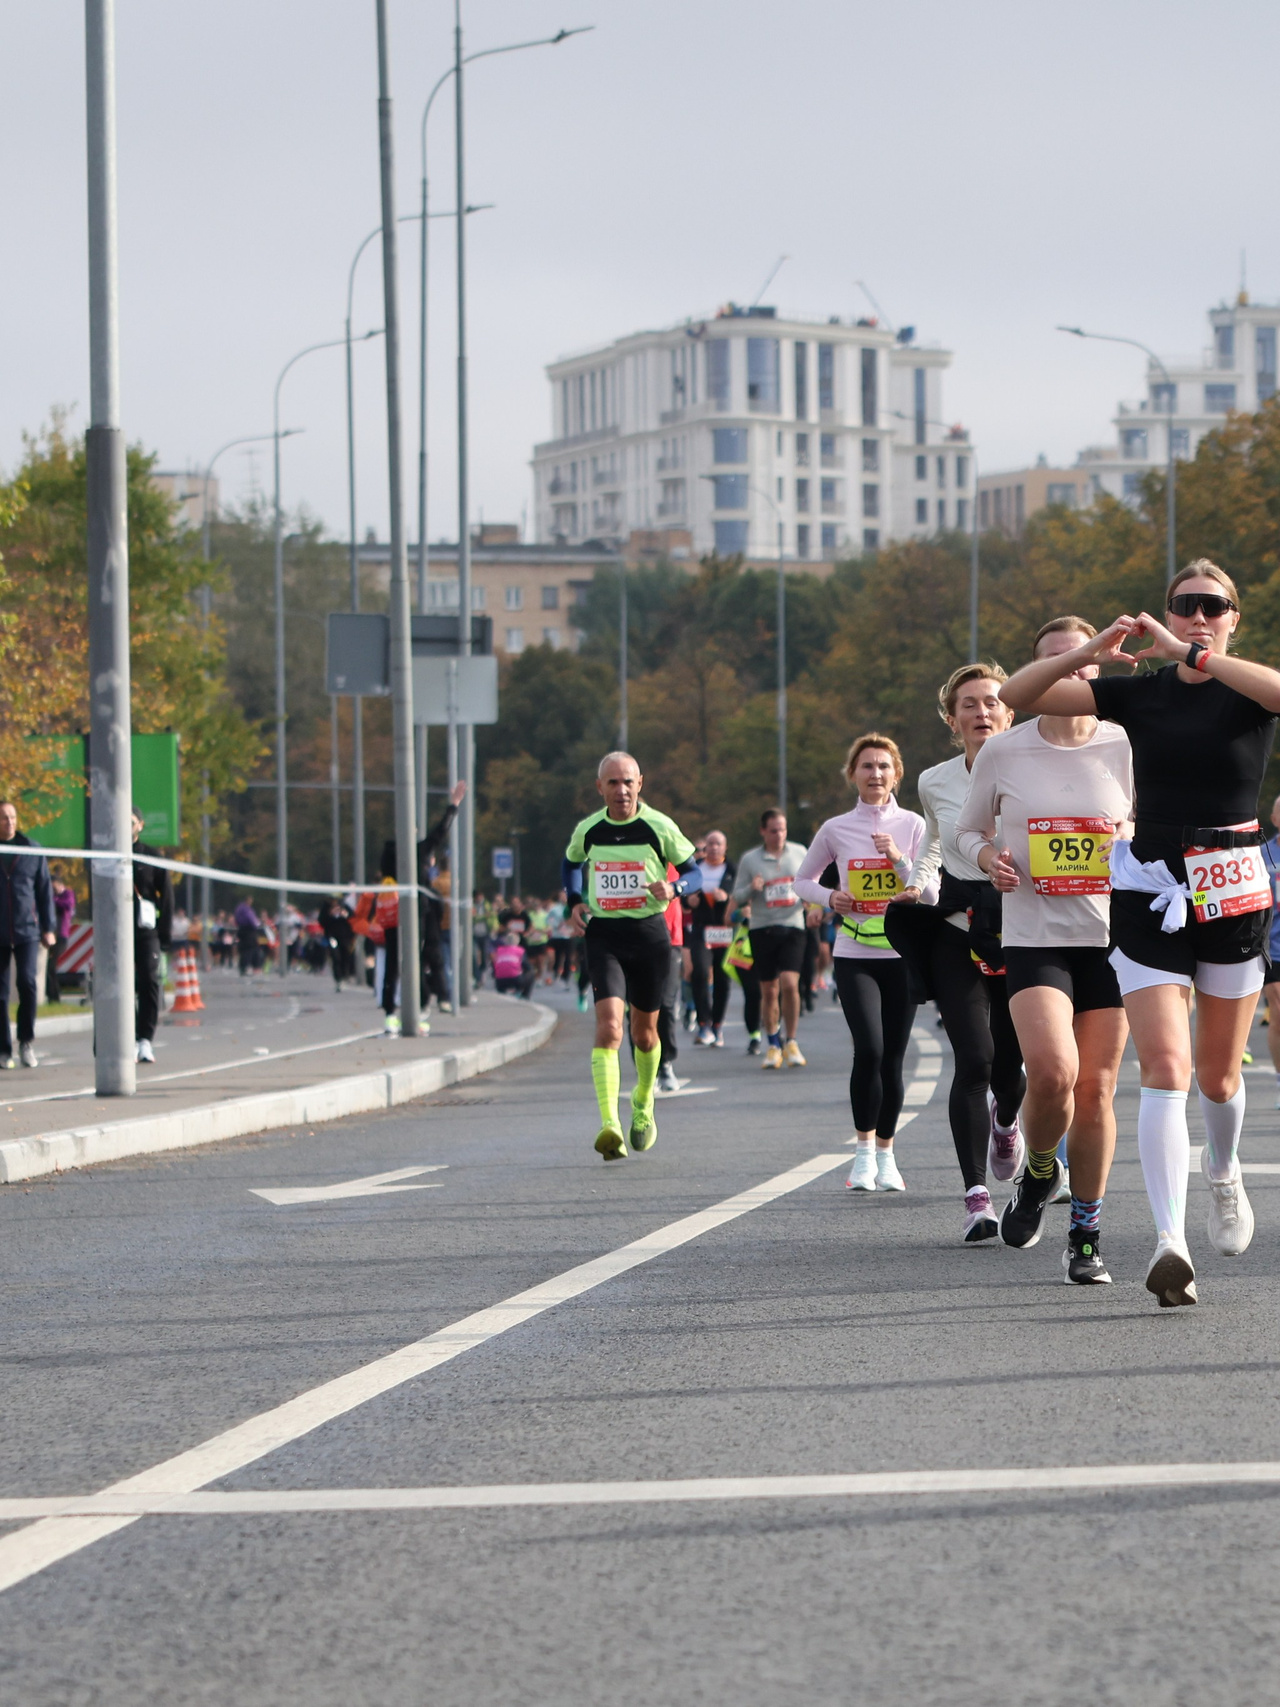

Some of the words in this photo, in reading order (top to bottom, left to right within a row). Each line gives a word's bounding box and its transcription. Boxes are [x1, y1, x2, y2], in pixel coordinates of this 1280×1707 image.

[1048, 838, 1095, 862] 959
[1056, 864, 1090, 872] МАРИНА
[1193, 854, 1264, 892] 28331
[601, 874, 639, 889] 3013
[862, 872, 896, 890] 213
[1040, 879, 1049, 893] E
[1194, 894, 1206, 903] VIP
[856, 903, 863, 912] E
[1208, 903, 1218, 917] D
[980, 963, 989, 974] E
